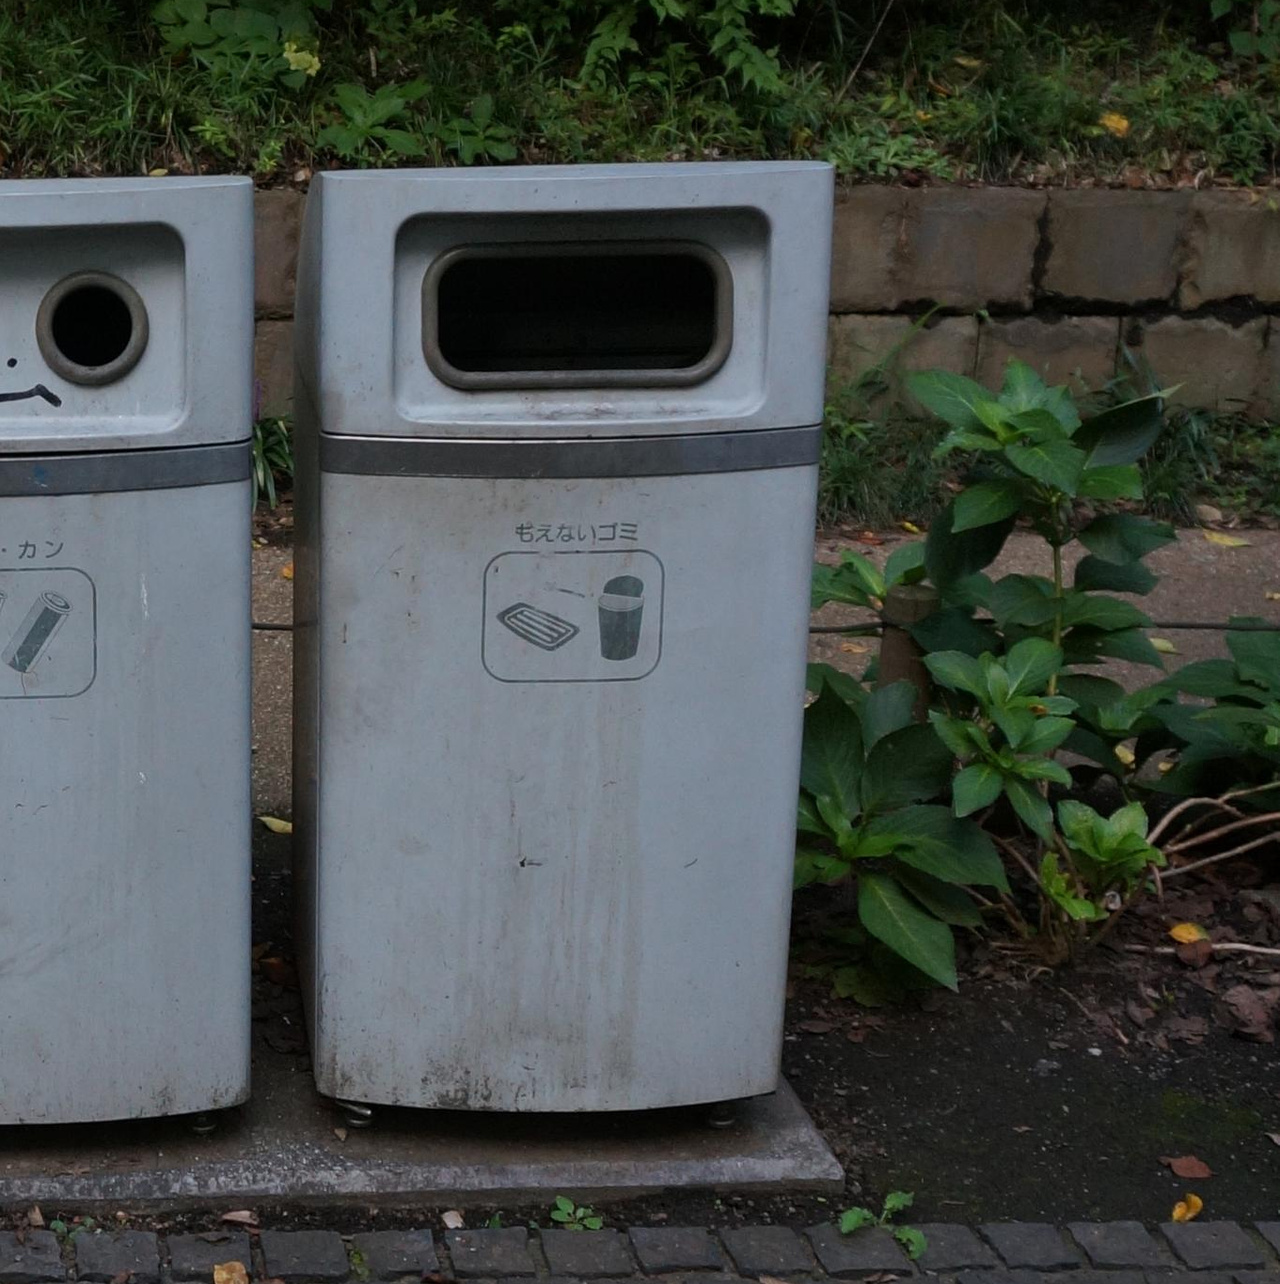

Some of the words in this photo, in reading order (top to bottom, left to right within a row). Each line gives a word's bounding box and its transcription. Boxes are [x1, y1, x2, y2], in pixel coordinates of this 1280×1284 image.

[515, 521, 639, 543] もえないゴミ
